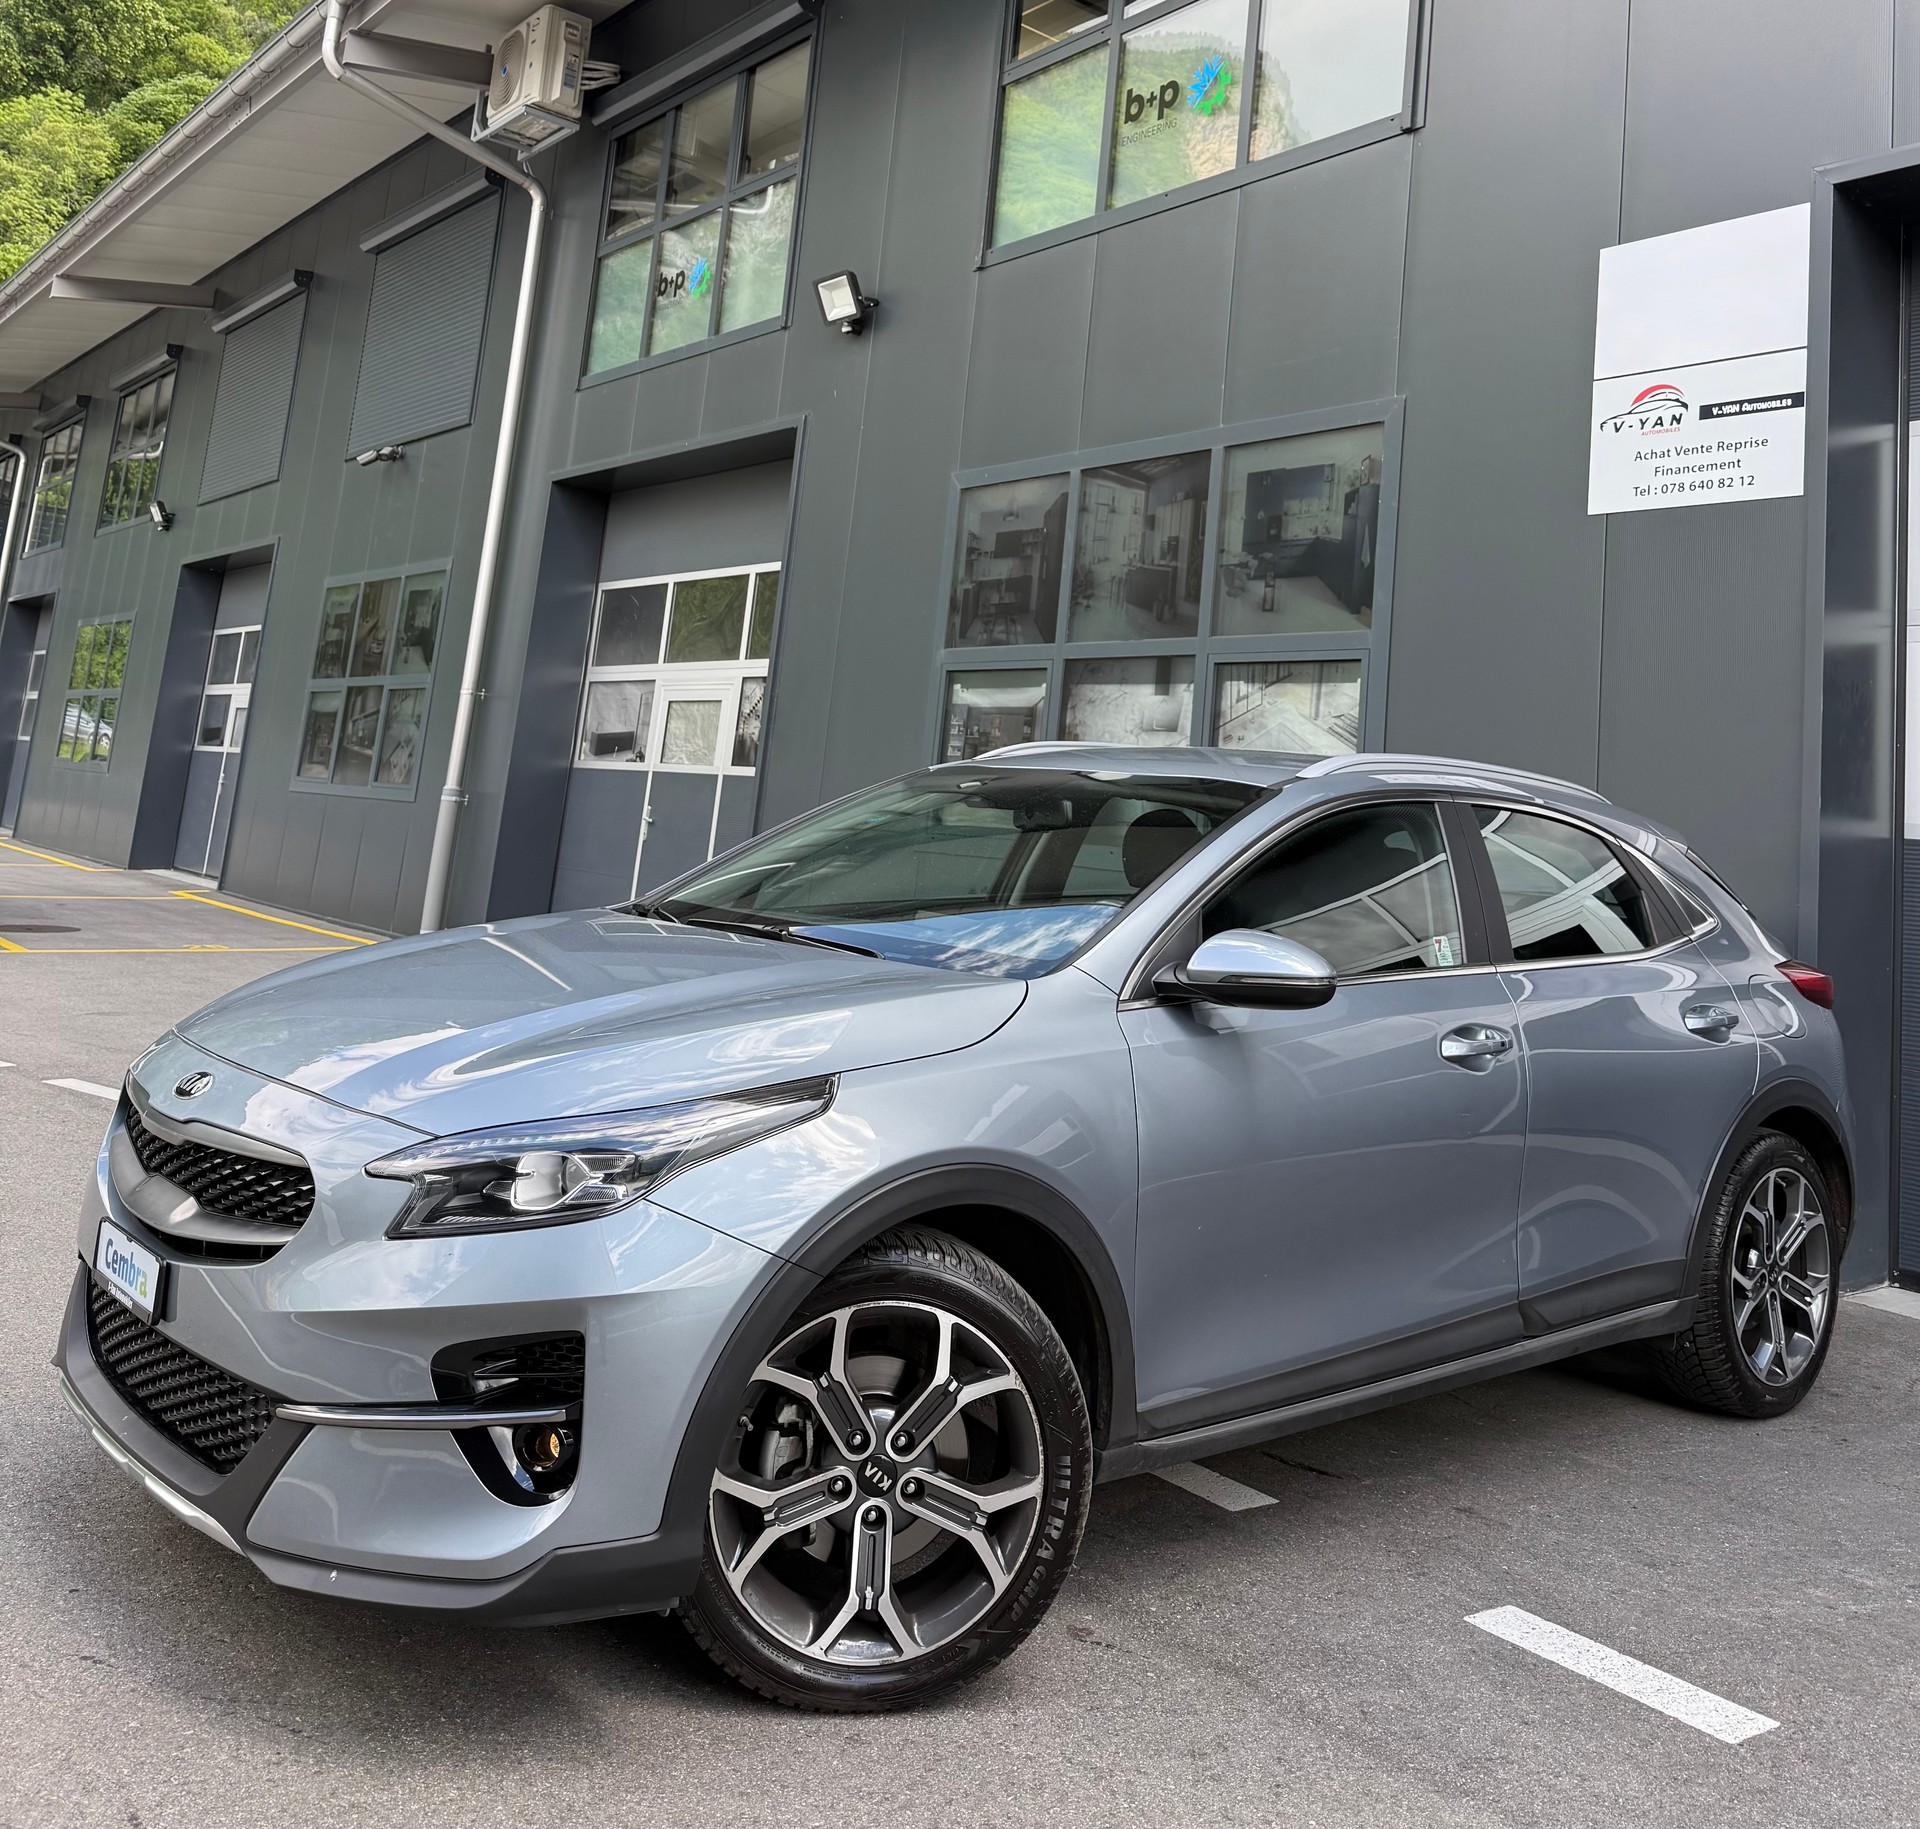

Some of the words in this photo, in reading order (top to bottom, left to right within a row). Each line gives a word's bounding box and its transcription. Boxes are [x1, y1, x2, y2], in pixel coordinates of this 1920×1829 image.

[1124, 80, 1180, 124] b+p
[1121, 117, 1178, 147] ENGINEERING
[657, 270, 685, 298] b+p
[1641, 426, 1681, 437] AUTOMOBILES
[1634, 448, 1671, 462] Achat
[1674, 444, 1713, 457] Vente
[1717, 437, 1769, 453] Reprise
[1654, 458, 1742, 477] Financement
[1661, 481, 1685, 495] 078
[1689, 479, 1714, 492] 640
[1717, 477, 1734, 489] 82
[1739, 475, 1755, 487] 12
[105, 1238, 148, 1298] Cembra
[864, 1461, 893, 1491] KIA
